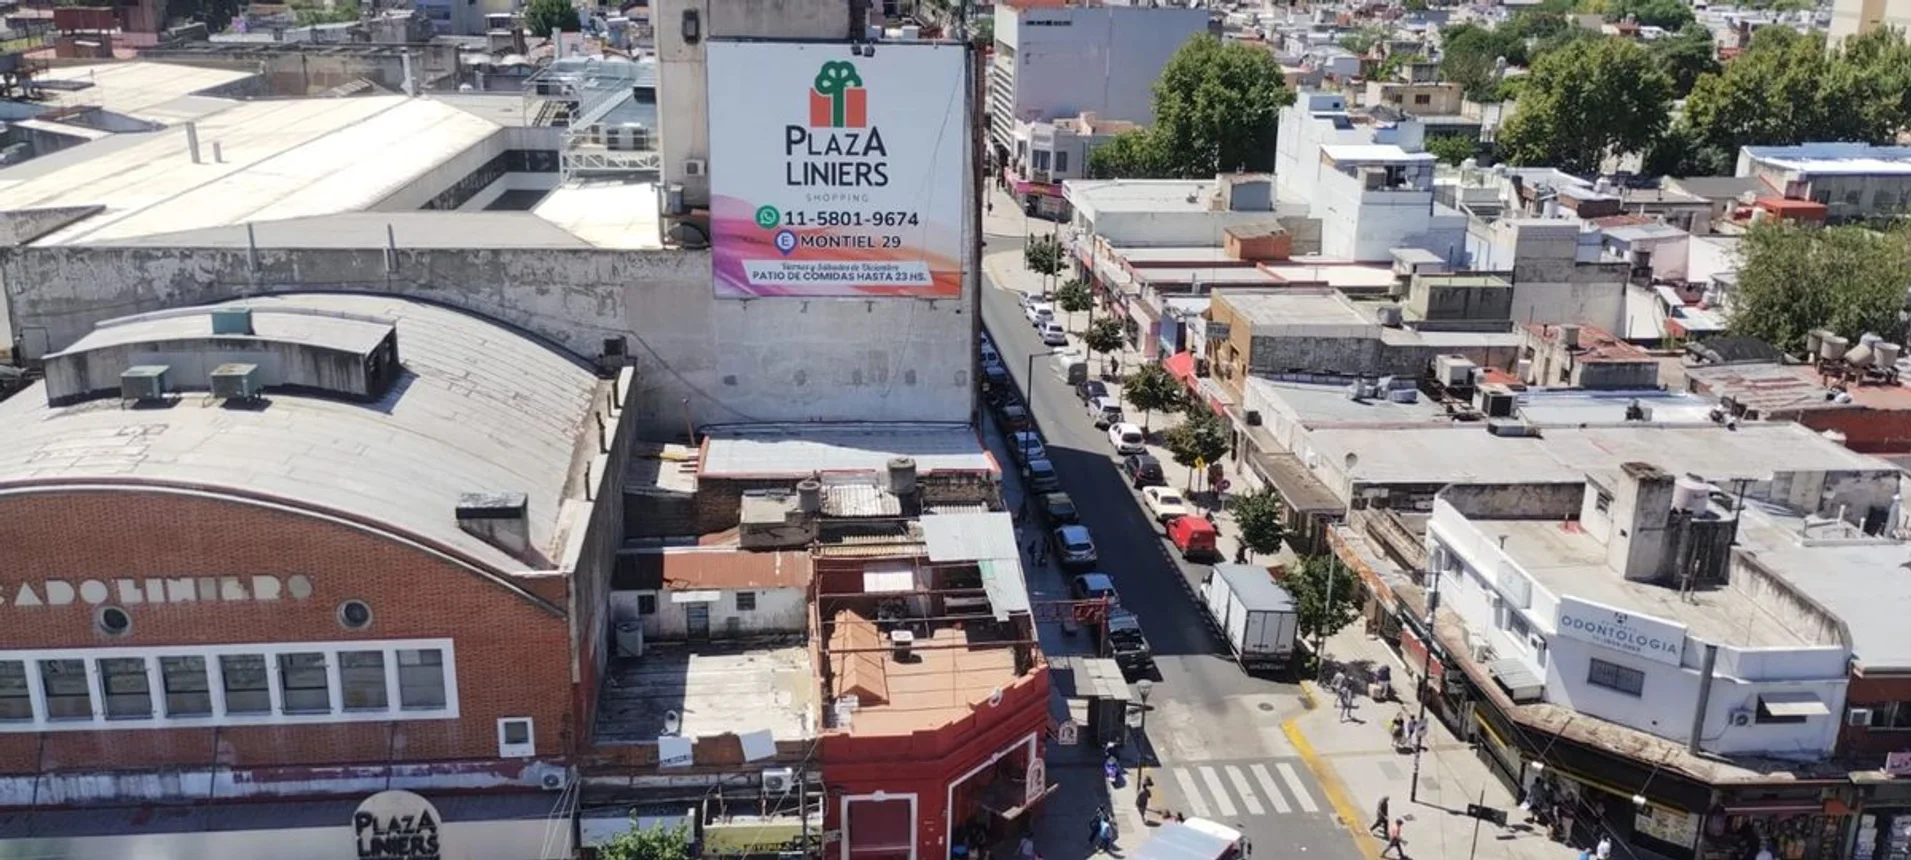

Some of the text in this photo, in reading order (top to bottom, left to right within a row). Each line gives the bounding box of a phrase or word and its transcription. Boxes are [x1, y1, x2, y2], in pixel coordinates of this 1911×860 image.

[786, 124, 887, 157] PLAZA
[786, 161, 889, 187] LINIERS
[805, 193, 869, 202] SHOPPING
[784, 211, 919, 227] 11-5801-9674
[800, 235, 876, 248] MONTIEL
[882, 236, 901, 248] 29
[753, 271, 785, 281] PATIO
[787, 271, 801, 281] DE
[803, 271, 854, 281] COMIDAS
[857, 272, 892, 281] HASTA
[895, 272, 907, 281] 23
[1561, 615, 1677, 655] ODONTOLOGIA
[355, 809, 437, 836] PLAZA
[357, 834, 440, 857] LINIERS
